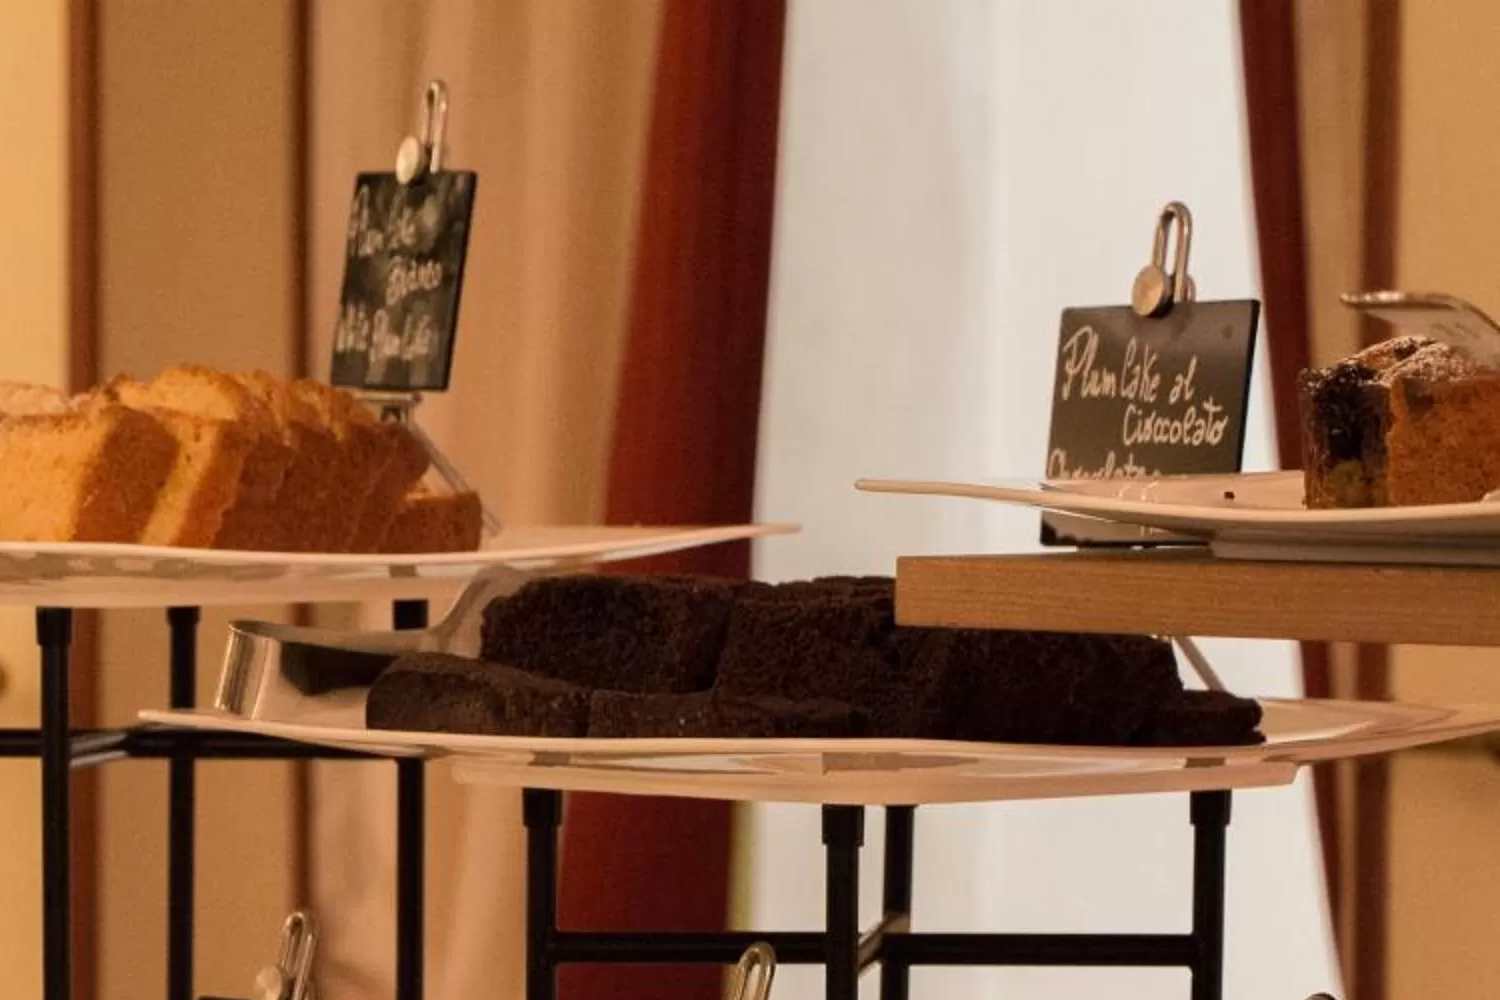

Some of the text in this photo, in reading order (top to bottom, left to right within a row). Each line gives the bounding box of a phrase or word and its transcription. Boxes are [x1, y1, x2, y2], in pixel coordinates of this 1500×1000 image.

[1061, 325, 1117, 400] Plum
[1169, 354, 1197, 405] al
[1123, 396, 1229, 447] Cioccolato
